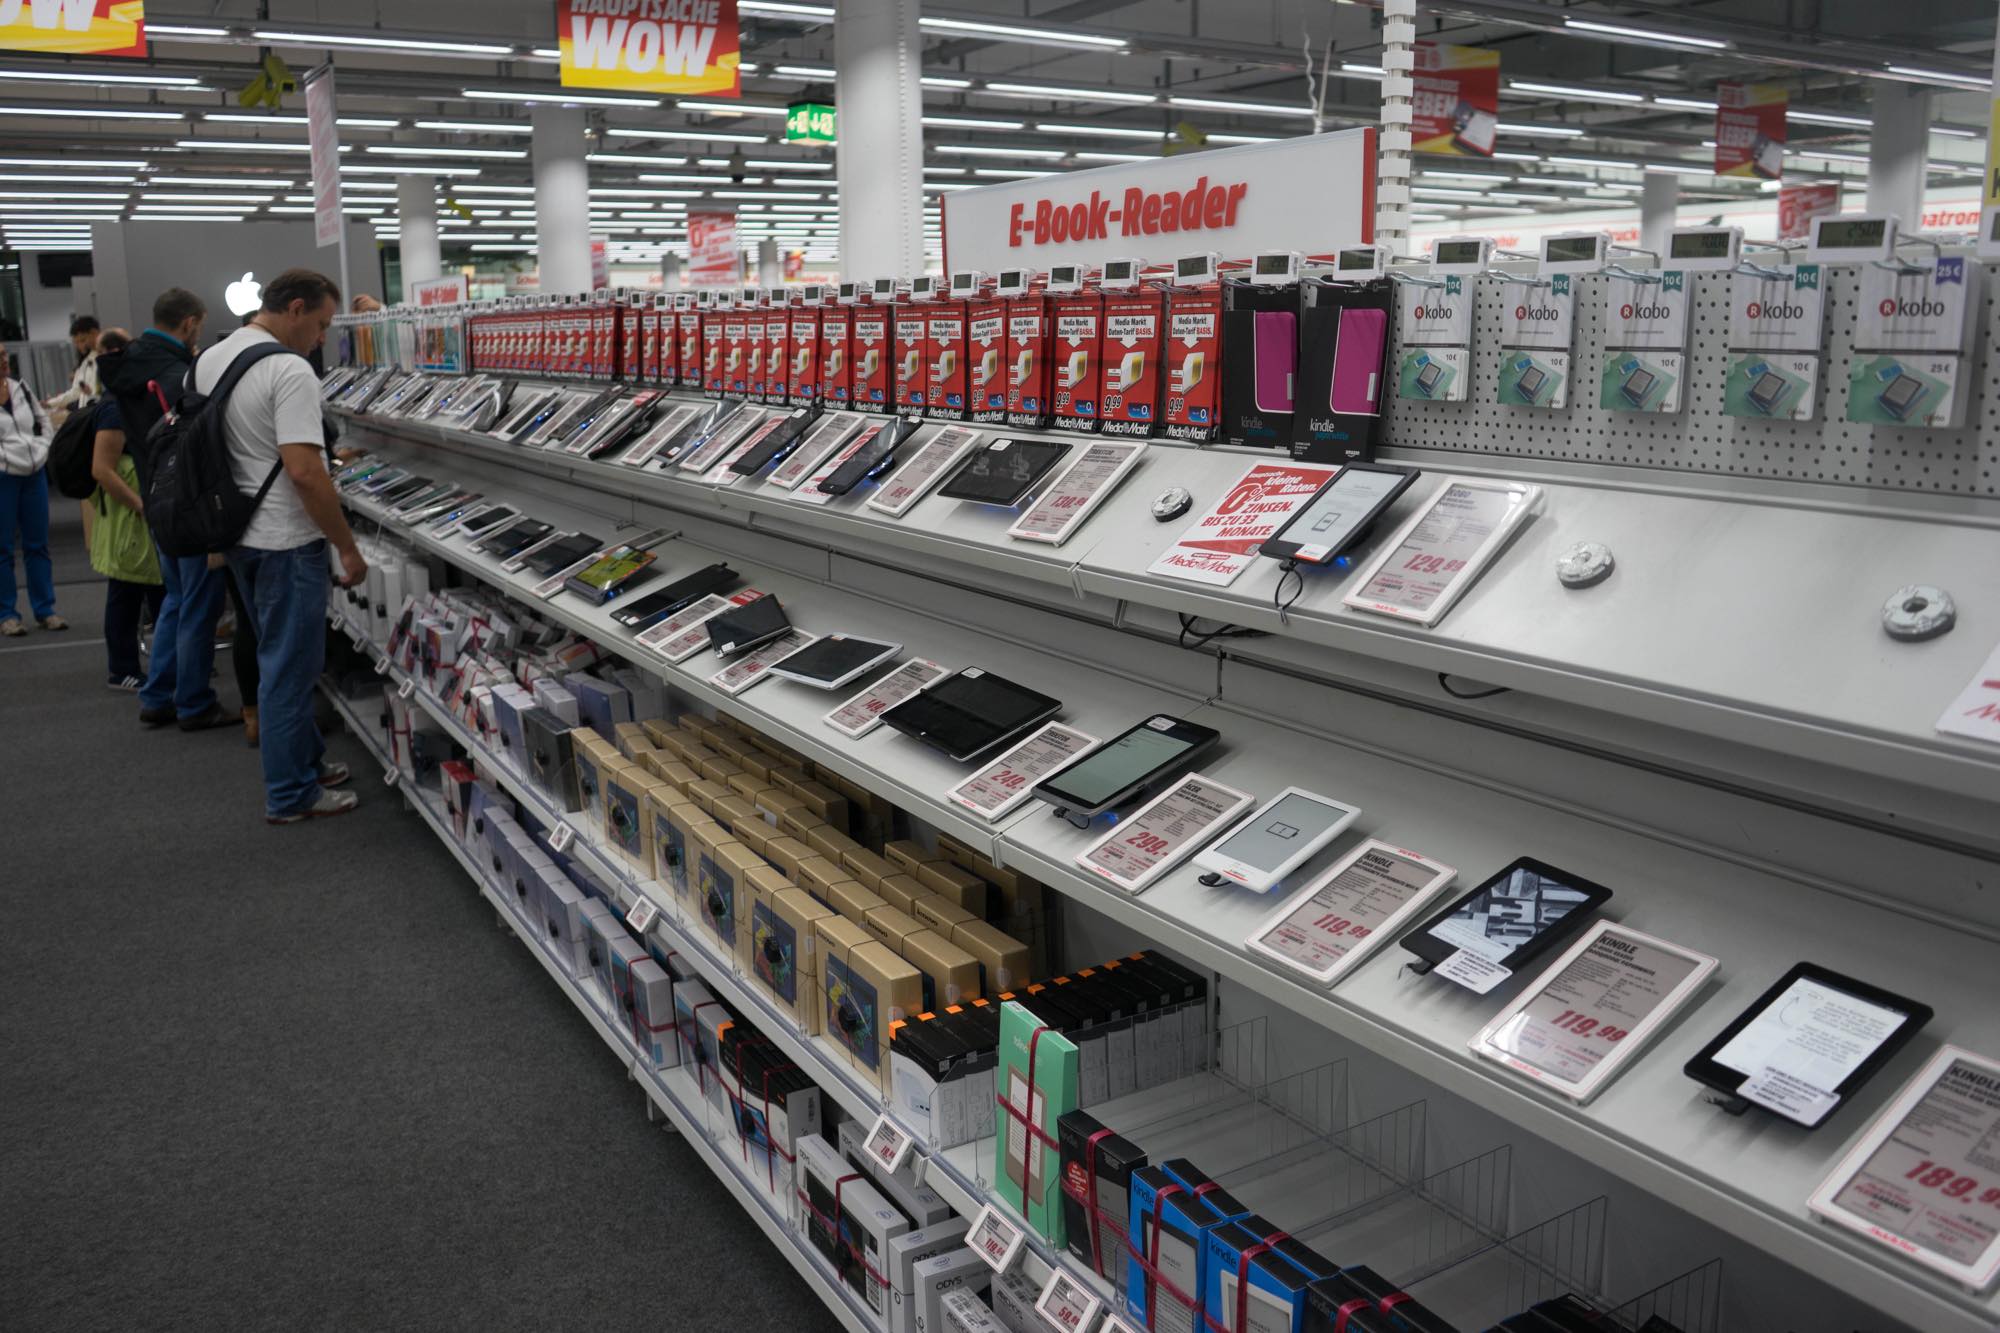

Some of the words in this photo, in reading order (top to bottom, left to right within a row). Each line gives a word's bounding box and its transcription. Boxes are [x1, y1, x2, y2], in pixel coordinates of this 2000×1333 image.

[571, 0, 721, 25] HAUPTSACHE
[571, 15, 717, 77] WOW
[1009, 176, 1247, 247] E-Book-Reader
[1425, 305, 1452, 319] kobo
[1528, 305, 1558, 320] kobo
[1634, 302, 1670, 319] kobo
[1763, 301, 1804, 319] kobo
[1898, 297, 1945, 317] kobo
[1131, 318, 1146, 326] Markt
[1178, 316, 1192, 325] Media
[1192, 316, 1207, 325] Markt
[1102, 421, 1123, 433] Media
[1128, 423, 1149, 436] Markt
[1241, 416, 1263, 429] kindle
[1310, 418, 1335, 432] kindle
[1166, 425, 1185, 438] Media
[1188, 427, 1207, 440] Markt
[1264, 475, 1303, 486] kleine
[1240, 501, 1294, 514] ZINSEN.
[1200, 516, 1224, 527] BIS
[1222, 515, 1243, 526] ZU
[1239, 514, 1260, 525] 33
[1215, 525, 1275, 538] MONATE.
[1364, 853, 1395, 868] KINDLE
[916, 908, 938, 926] lenovo
[867, 919, 888, 938] lenovo
[1599, 936, 1639, 954] KINDLE
[1211, 1239, 1237, 1268] kindle
[936, 1276, 962, 1291] ODYS
